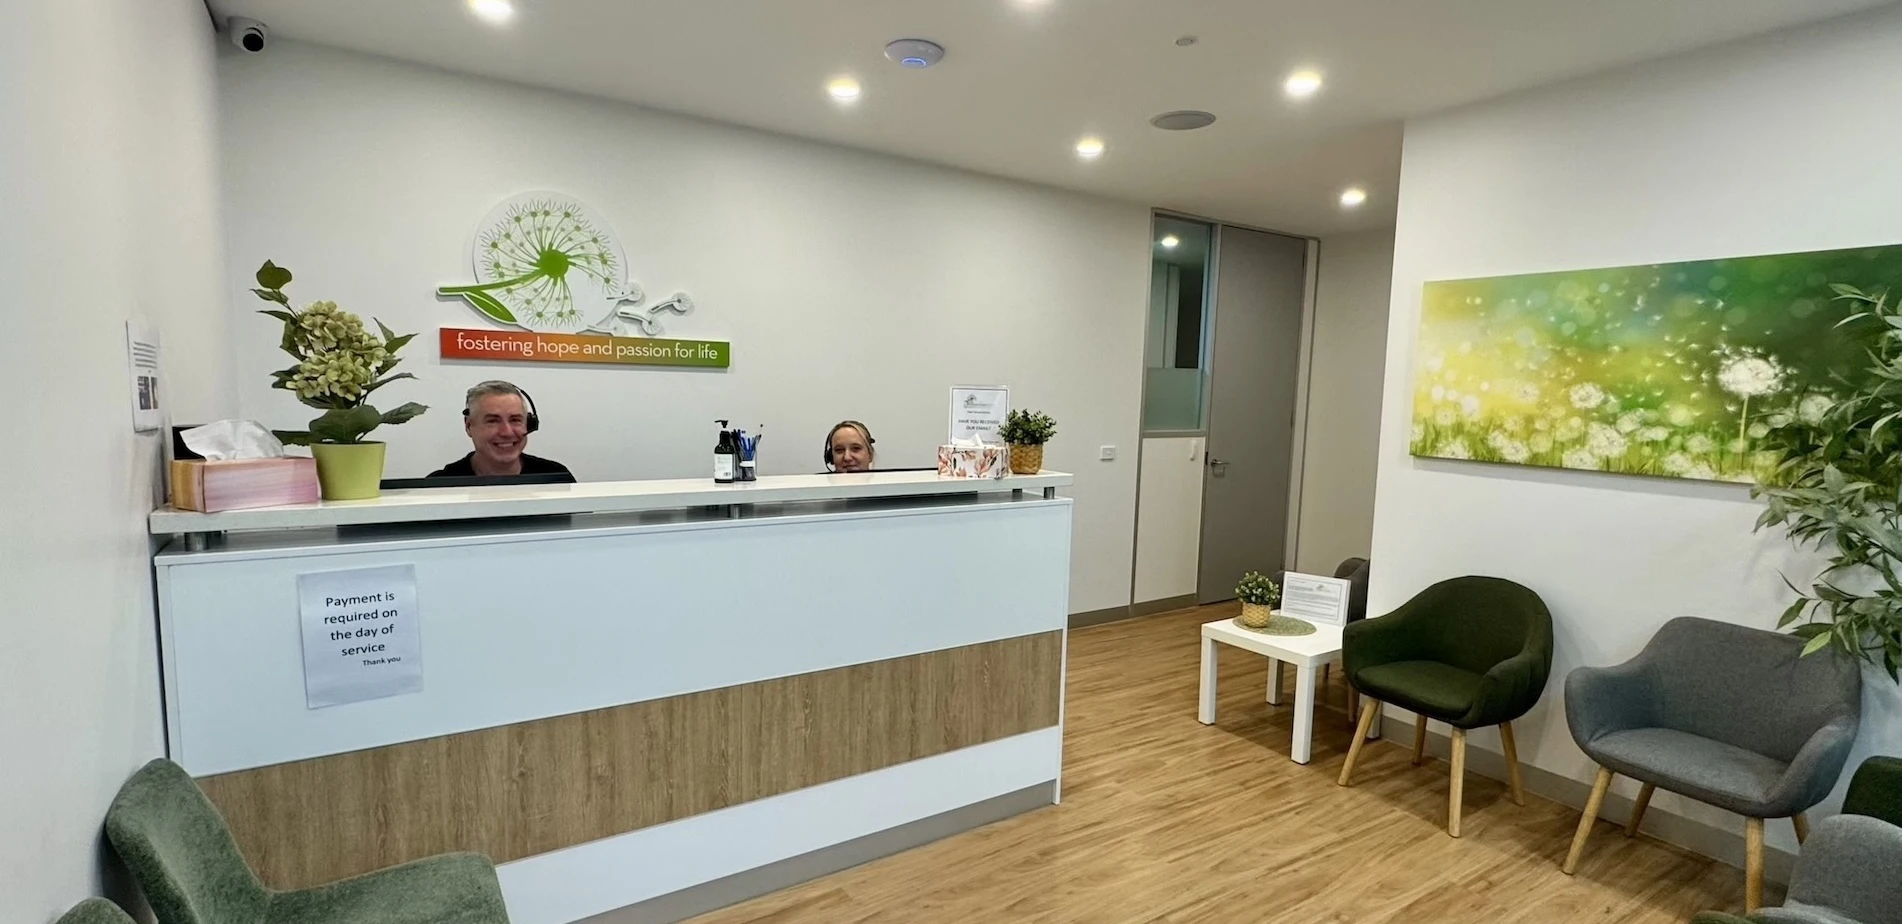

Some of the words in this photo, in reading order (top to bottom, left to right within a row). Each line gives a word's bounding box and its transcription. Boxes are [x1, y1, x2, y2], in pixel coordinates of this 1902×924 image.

[456, 332, 533, 357] fostering
[537, 336, 579, 357] hope
[583, 340, 612, 355] and
[616, 343, 670, 359] passion
[674, 344, 695, 359] for
[698, 343, 718, 360] life
[326, 593, 382, 607] Payment
[385, 592, 395, 601] is
[324, 609, 378, 624] required
[382, 609, 398, 618] on
[330, 630, 352, 641] the
[355, 628, 378, 638] day
[381, 624, 394, 634] of
[341, 643, 385, 656] service
[363, 658, 385, 666] Thank
